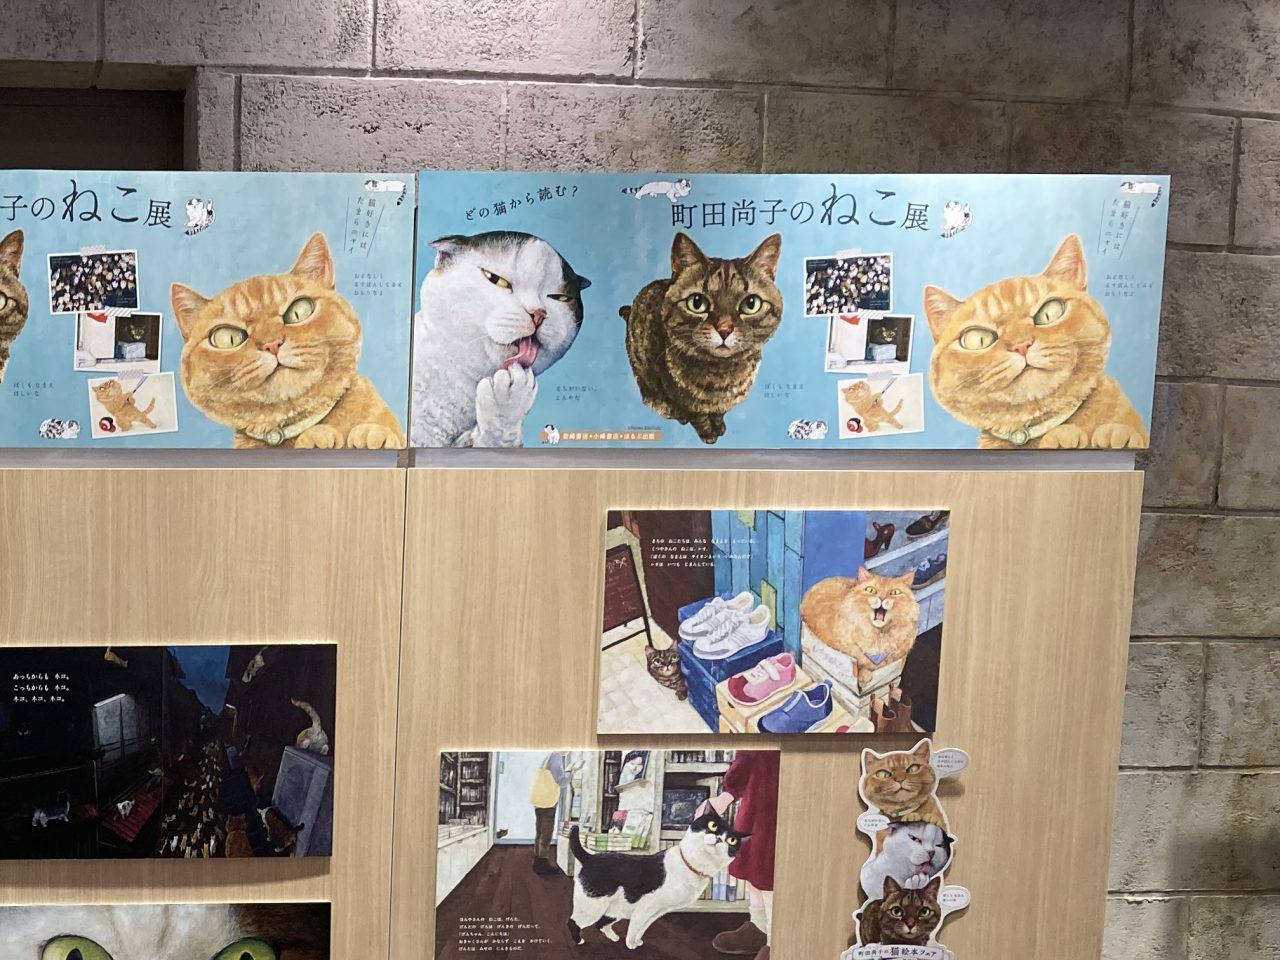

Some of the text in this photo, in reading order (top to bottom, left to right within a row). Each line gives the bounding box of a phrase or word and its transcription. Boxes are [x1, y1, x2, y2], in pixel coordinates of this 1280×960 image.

[465, 185, 578, 221] どの猫から読む？
[671, 182, 930, 231] 町田尚子のねこ展
